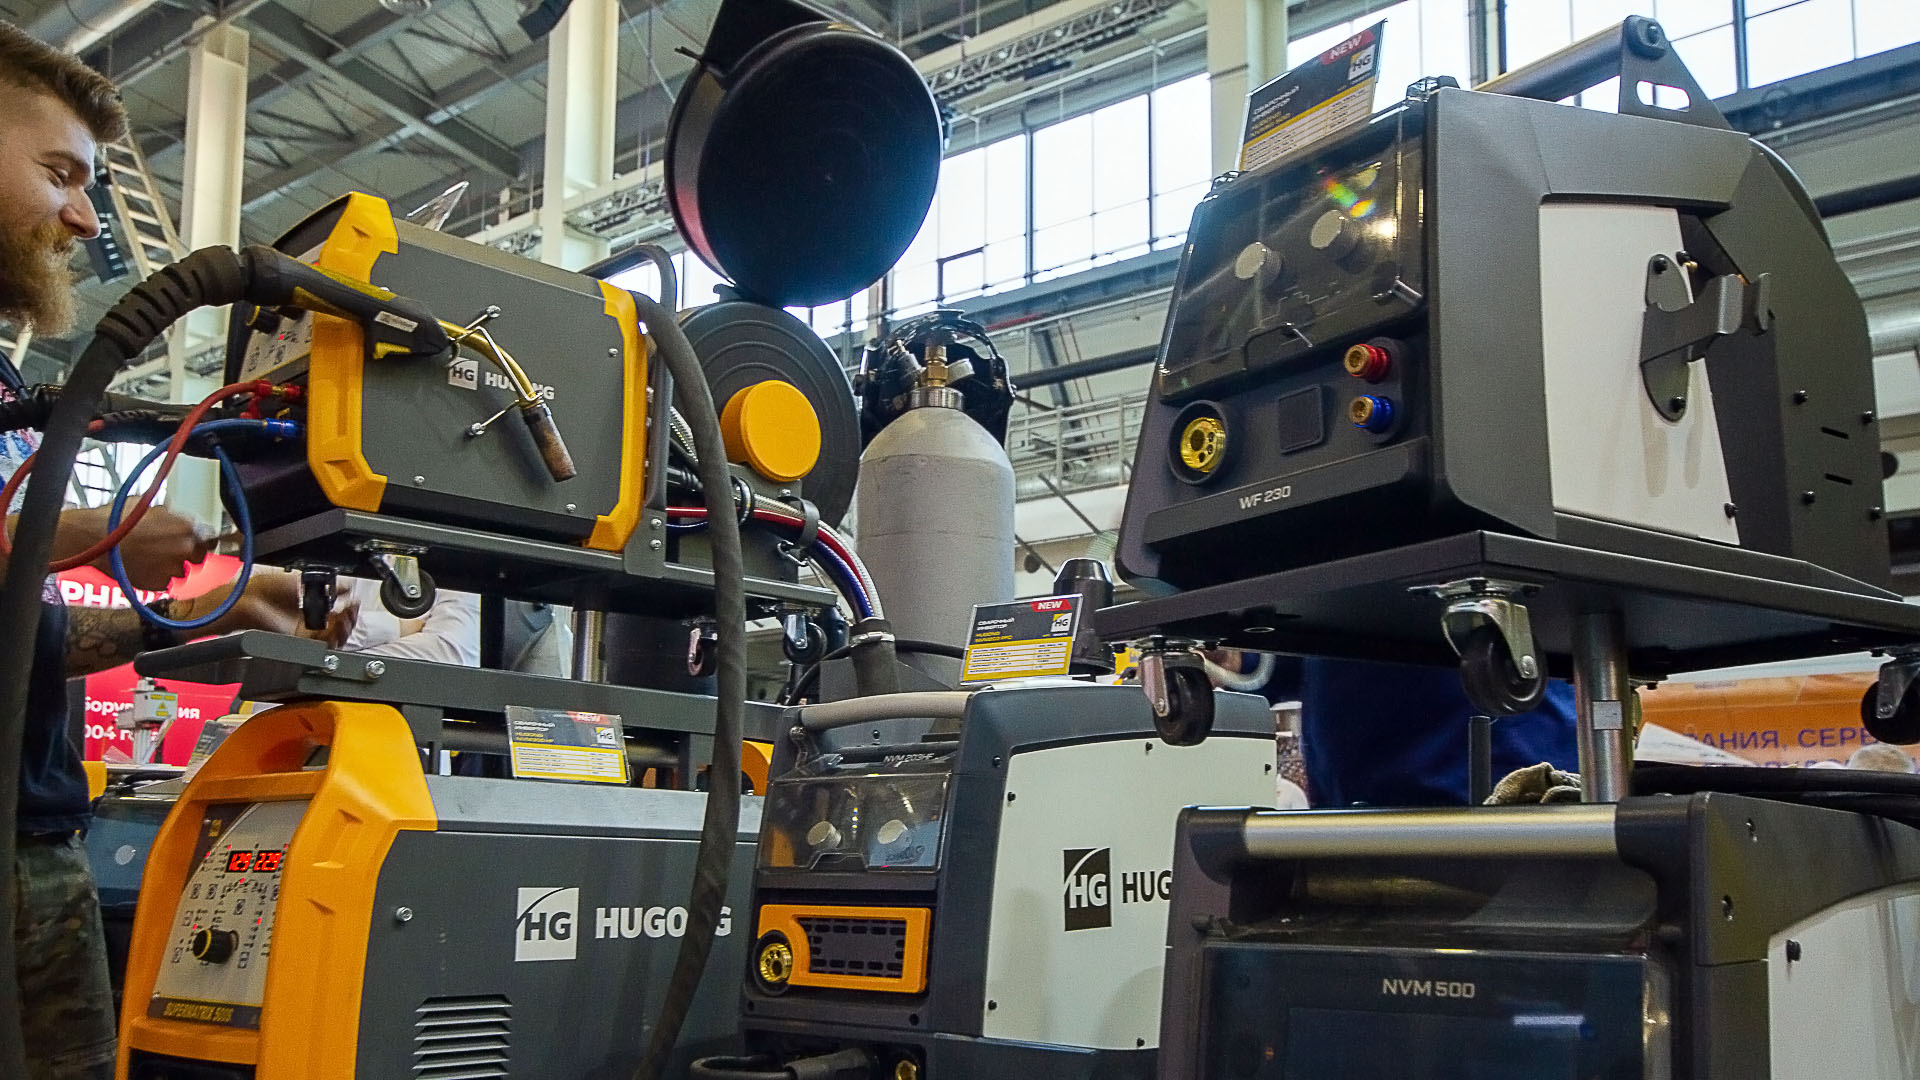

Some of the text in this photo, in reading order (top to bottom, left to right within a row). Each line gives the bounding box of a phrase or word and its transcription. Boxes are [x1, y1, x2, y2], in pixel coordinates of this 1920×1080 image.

[1329, 34, 1362, 60] NEW
[453, 366, 555, 400] HG HUNG
[1037, 600, 1063, 610] NEW
[1055, 618, 1069, 627] HG
[600, 732, 613, 740] HG
[1069, 873, 1108, 909] HG
[523, 905, 732, 941] HG HUGOG
